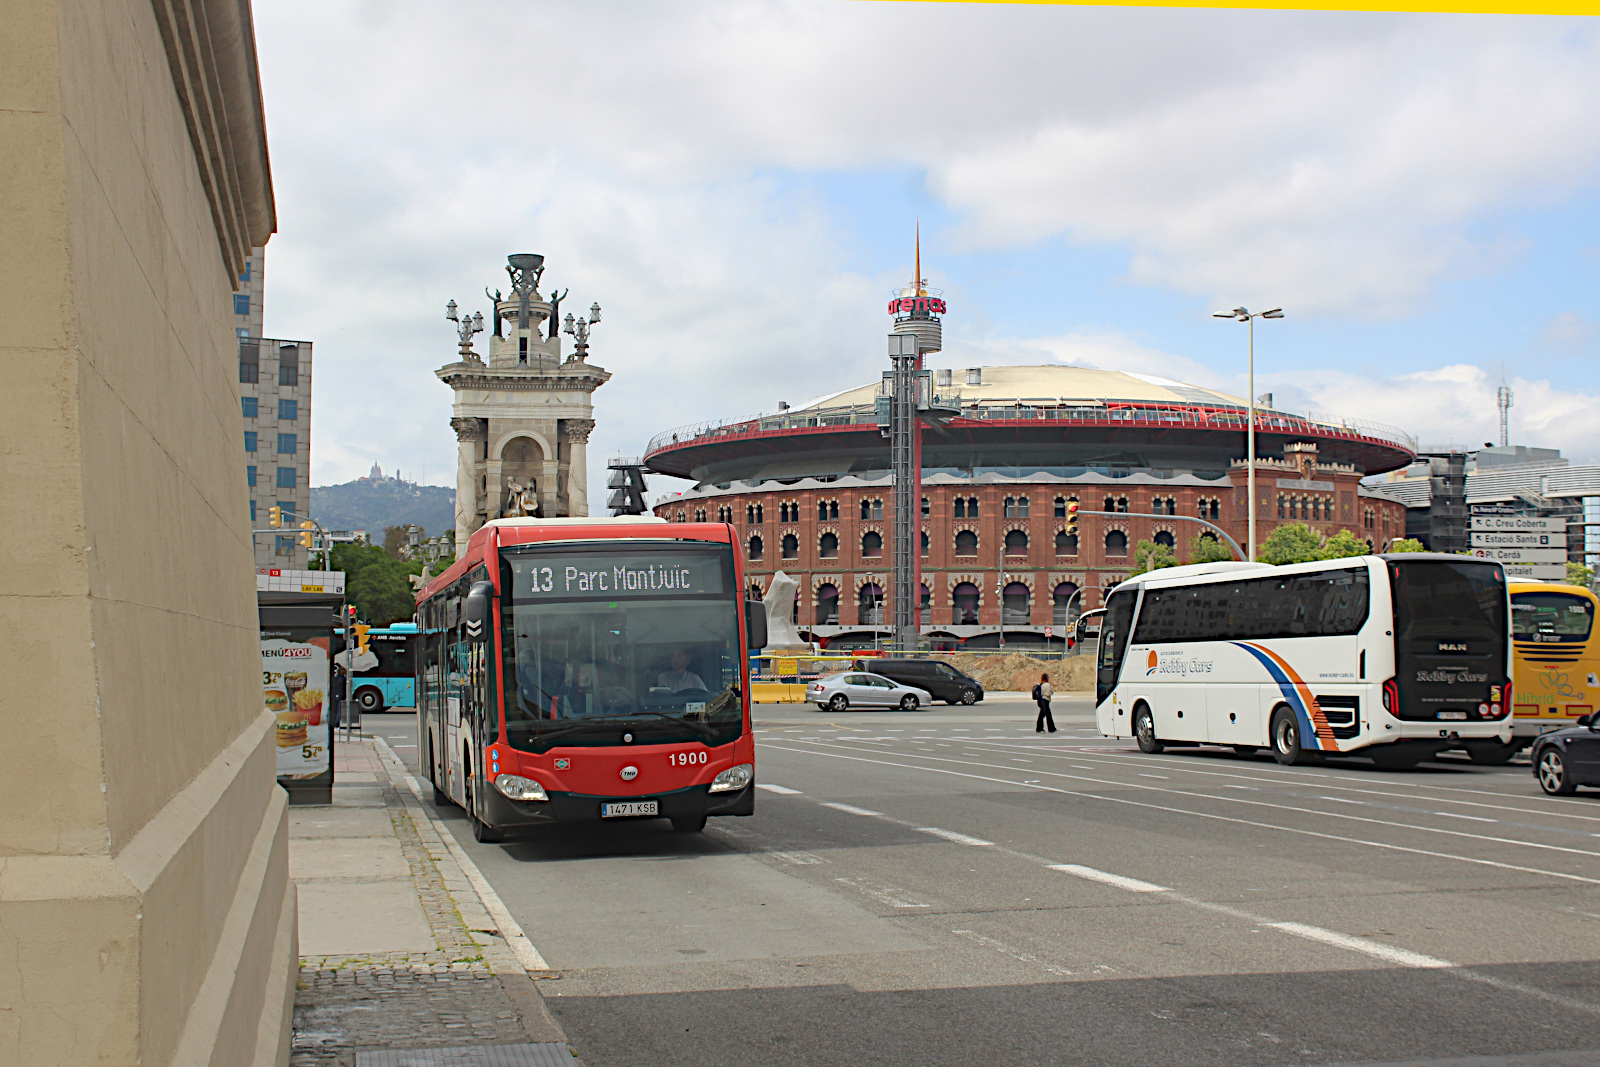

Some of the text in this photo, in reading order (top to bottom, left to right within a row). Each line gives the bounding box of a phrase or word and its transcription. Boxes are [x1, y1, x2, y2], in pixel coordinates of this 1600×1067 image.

[888, 298, 946, 315] arenas
[1485, 519, 1547, 527] C. Creu Coberta
[1485, 534, 1537, 543] Estació Sants
[1498, 550, 1521, 558] Cerdà
[1504, 566, 1533, 576] spitalet
[531, 564, 690, 592] 13 Parc Montjuïc
[1438, 643, 1467, 651] MAN
[669, 751, 708, 766] 1900
[610, 803, 656, 815] 1471 KSB
